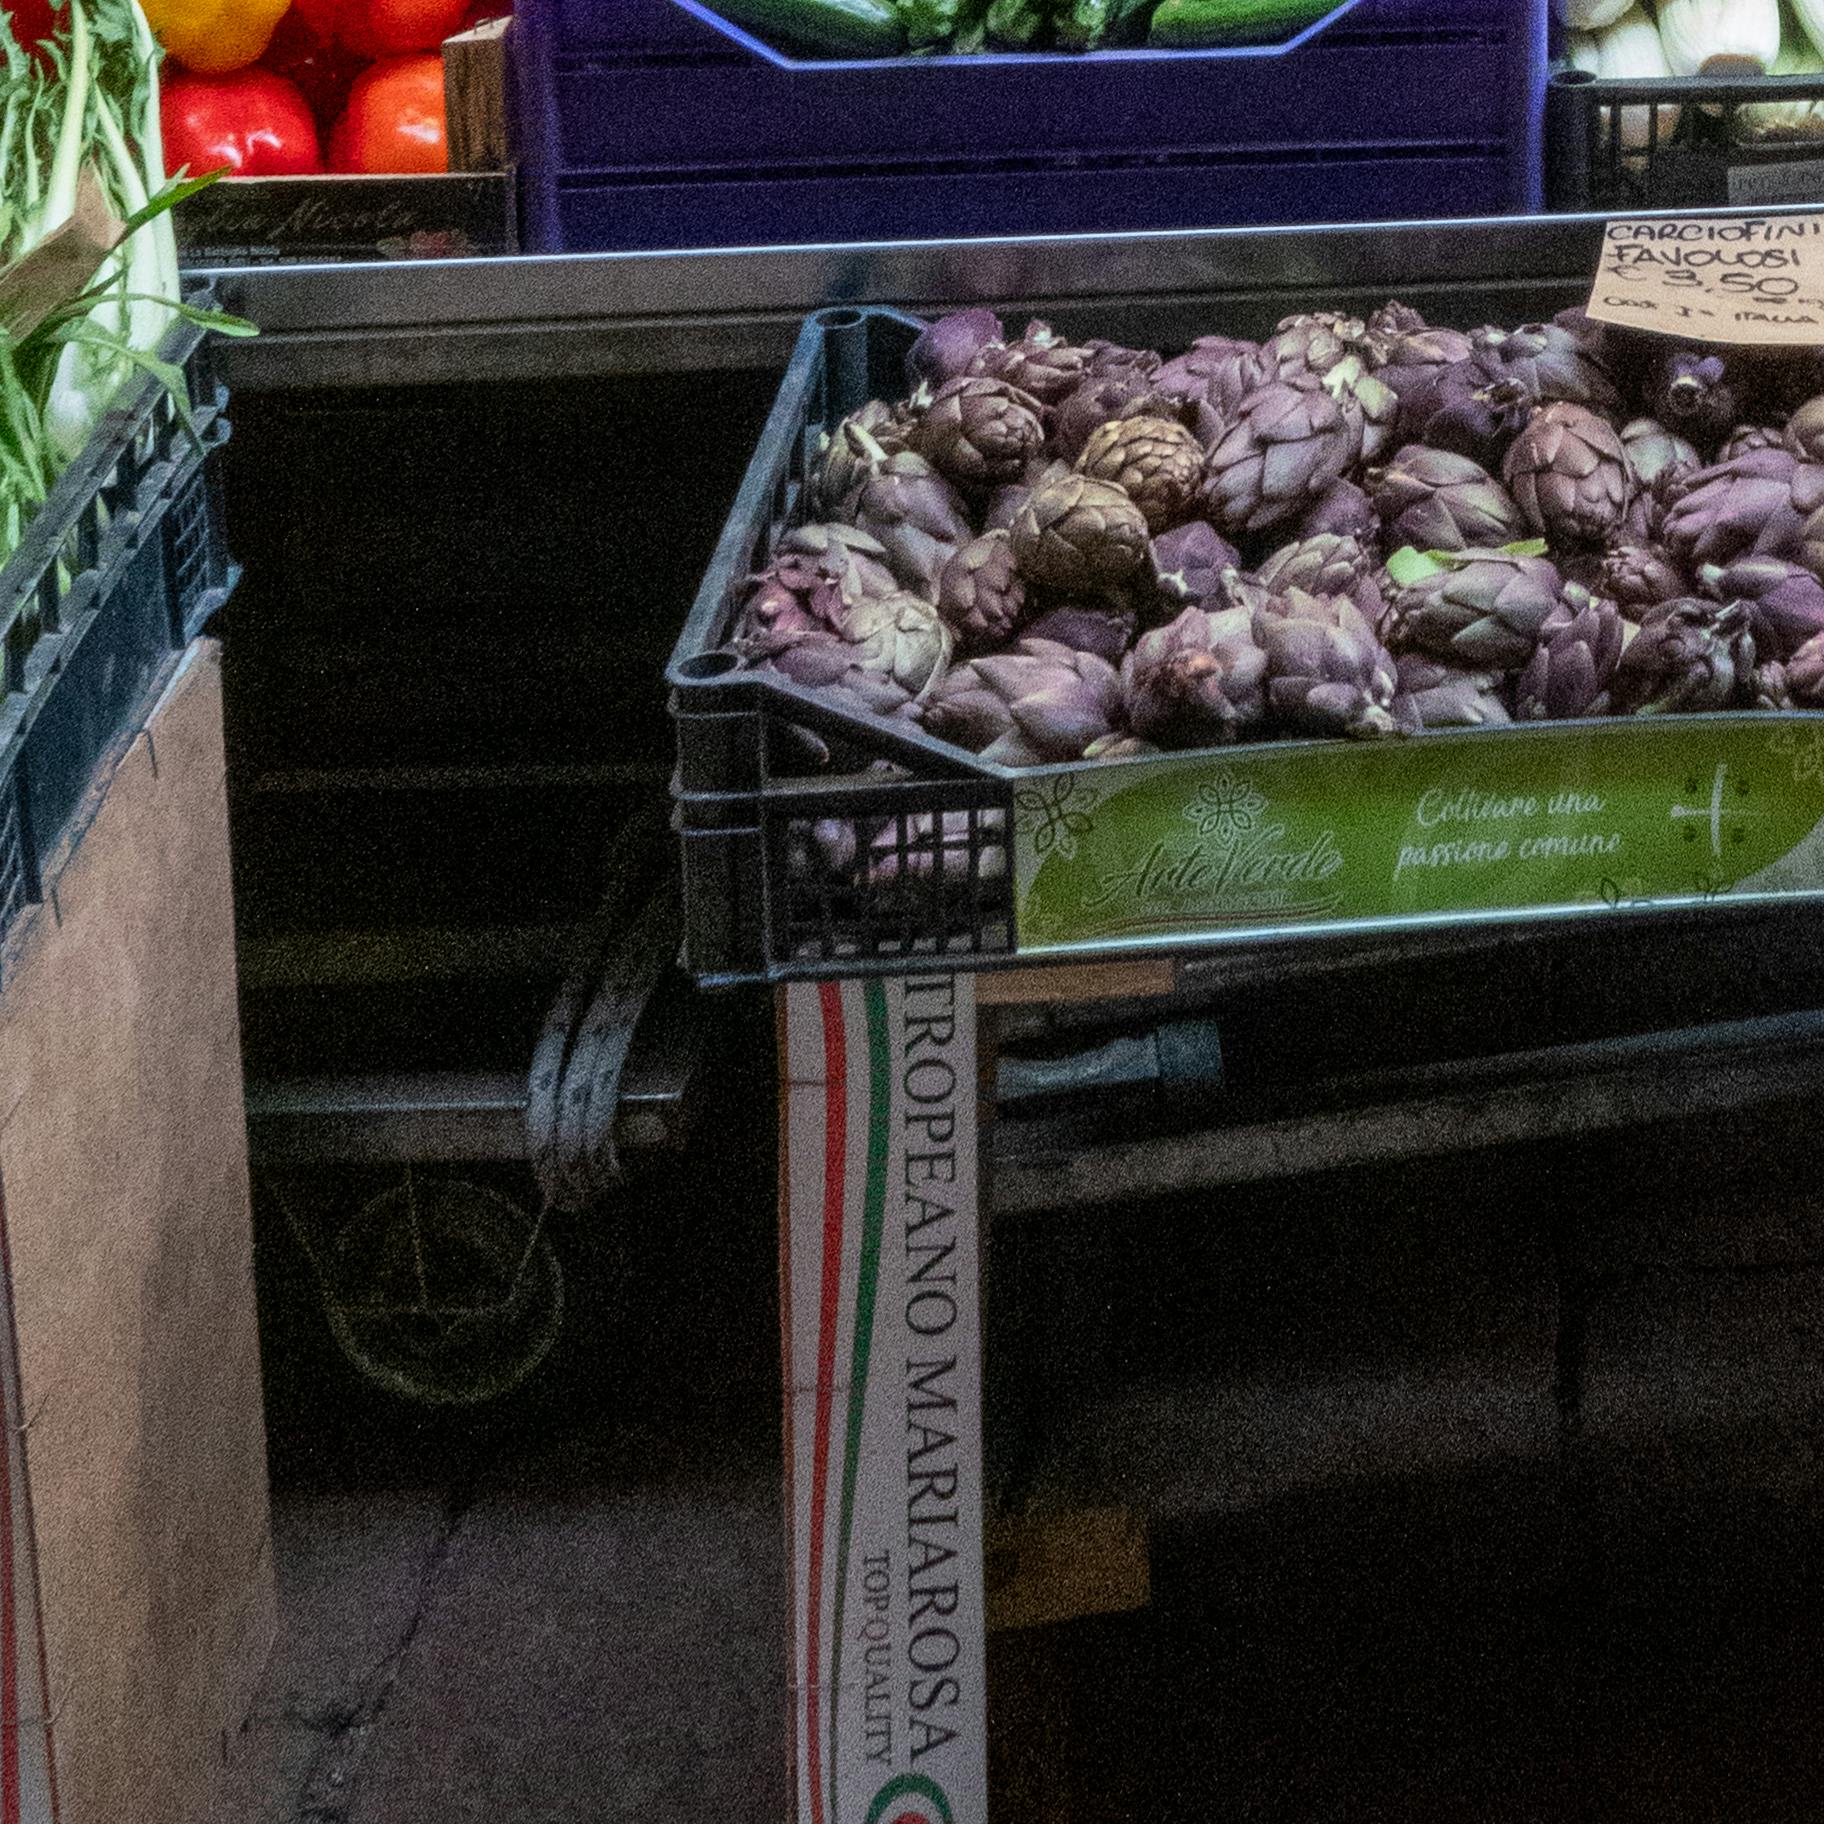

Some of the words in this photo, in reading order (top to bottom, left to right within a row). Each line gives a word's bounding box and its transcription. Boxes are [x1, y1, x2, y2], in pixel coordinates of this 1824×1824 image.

[1607, 220, 1821, 242] CARCIOFINI
[1607, 244, 1801, 269] FAVOLOSI
[1547, 790, 1607, 816] una
[1391, 838, 1511, 882] passione
[1518, 832, 1623, 860] comune
[904, 972, 958, 1338] TROPEANO
[863, 1552, 892, 1616] TOP
[904, 1359, 963, 1765] MARIAROSA
[863, 1617, 894, 1768] QUALITY
